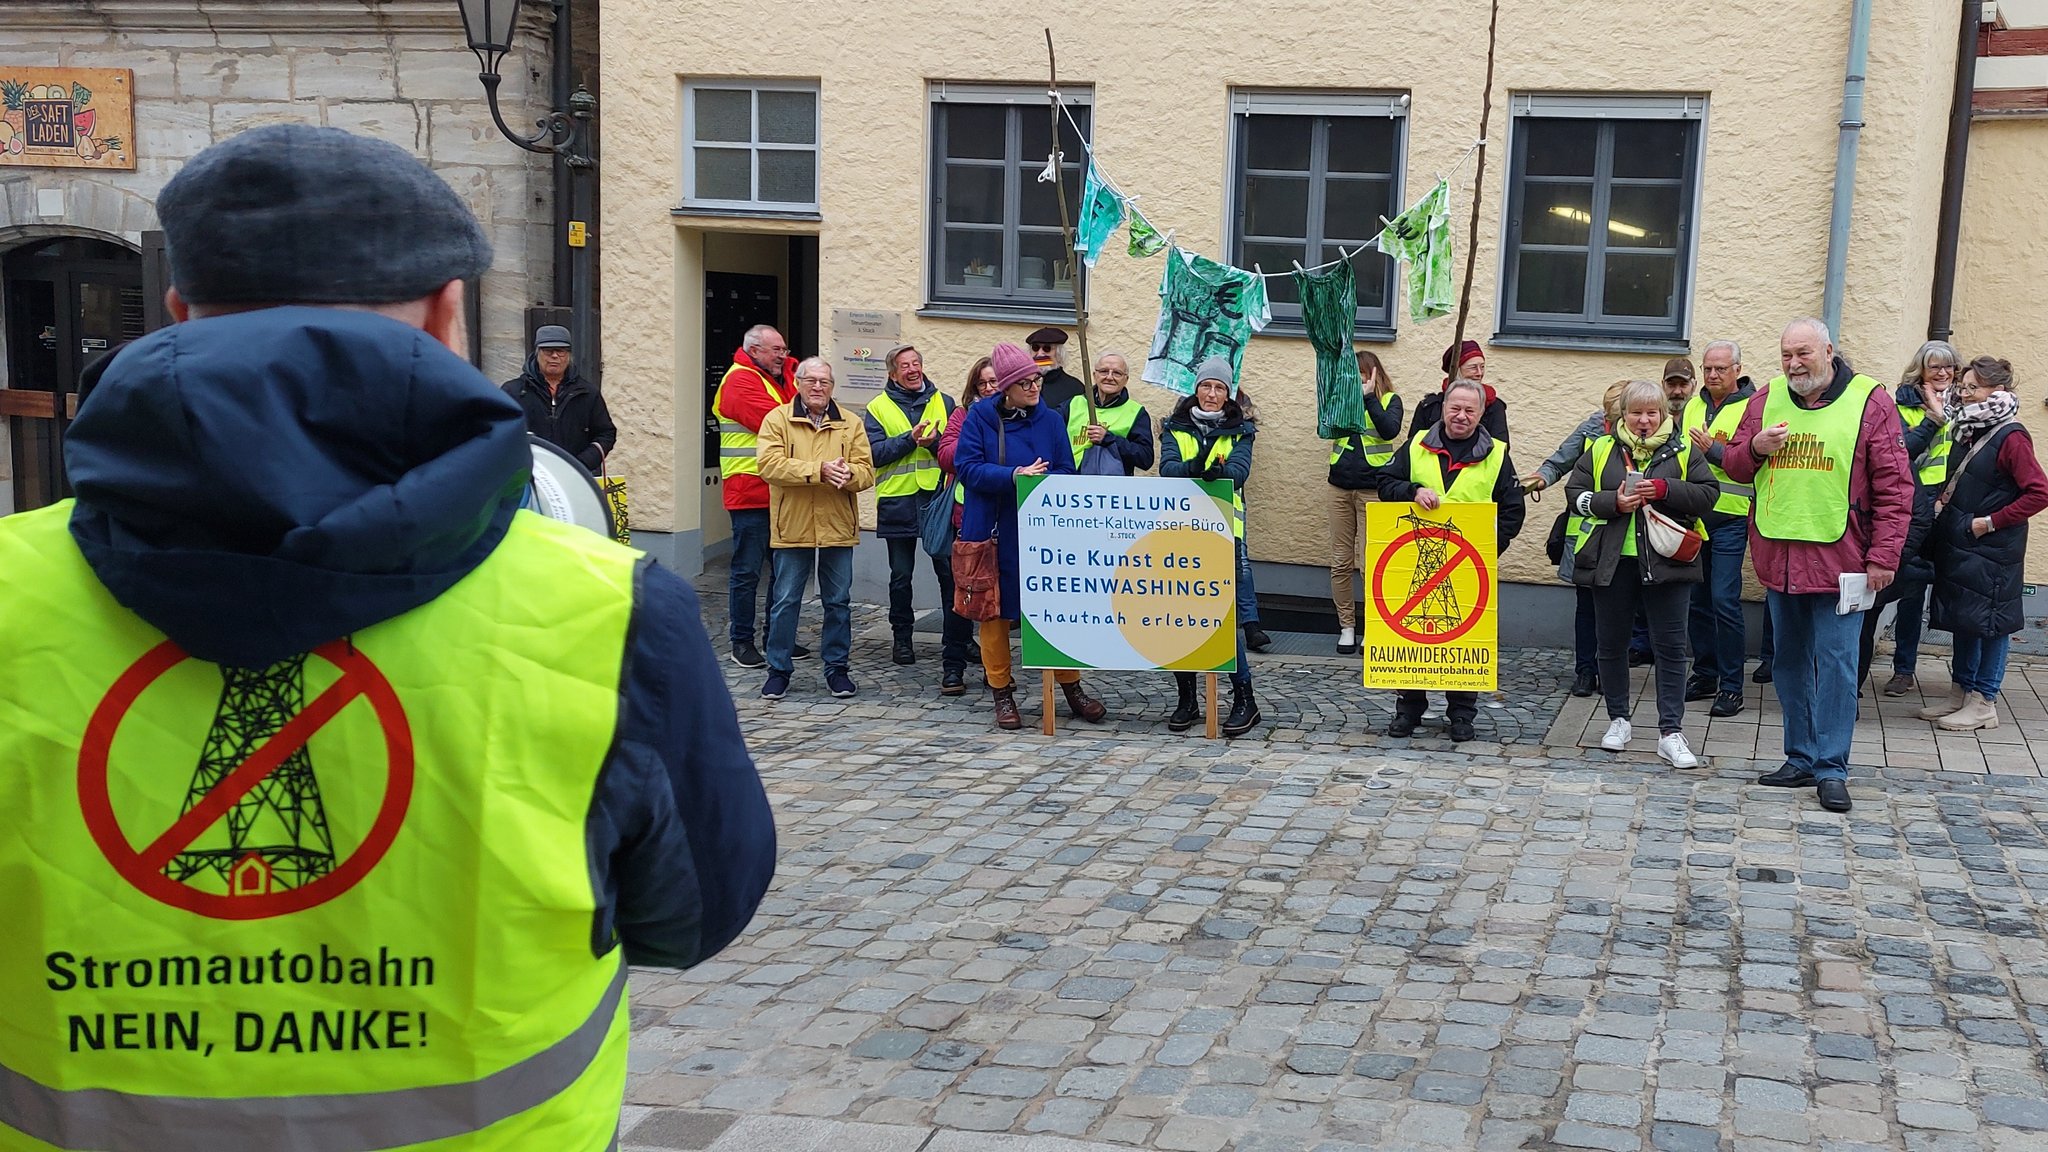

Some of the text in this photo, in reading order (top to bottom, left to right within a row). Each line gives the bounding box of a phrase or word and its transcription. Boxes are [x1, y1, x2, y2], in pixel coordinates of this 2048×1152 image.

[26, 104, 69, 123] DER SAFT
[32, 123, 69, 143] LADEN
[1768, 456, 1834, 471] WIDERSTAND
[1041, 493, 1191, 511] AUSSTELLUNG
[1028, 514, 1225, 532] im Tennet-Kaltwasser-Büro
[1088, 549, 1152, 568] Kunst
[1163, 552, 1202, 569] des
[1141, 612, 1223, 628] erleben
[1370, 646, 1490, 665] RAUMWIDERSTAND
[1370, 666, 1490, 675] www.stromautobahn.de
[1439, 675, 1490, 688] Energiewende
[45, 944, 435, 991] Stromautobahn
[67, 1009, 428, 1058] NEIN, DANKE!
